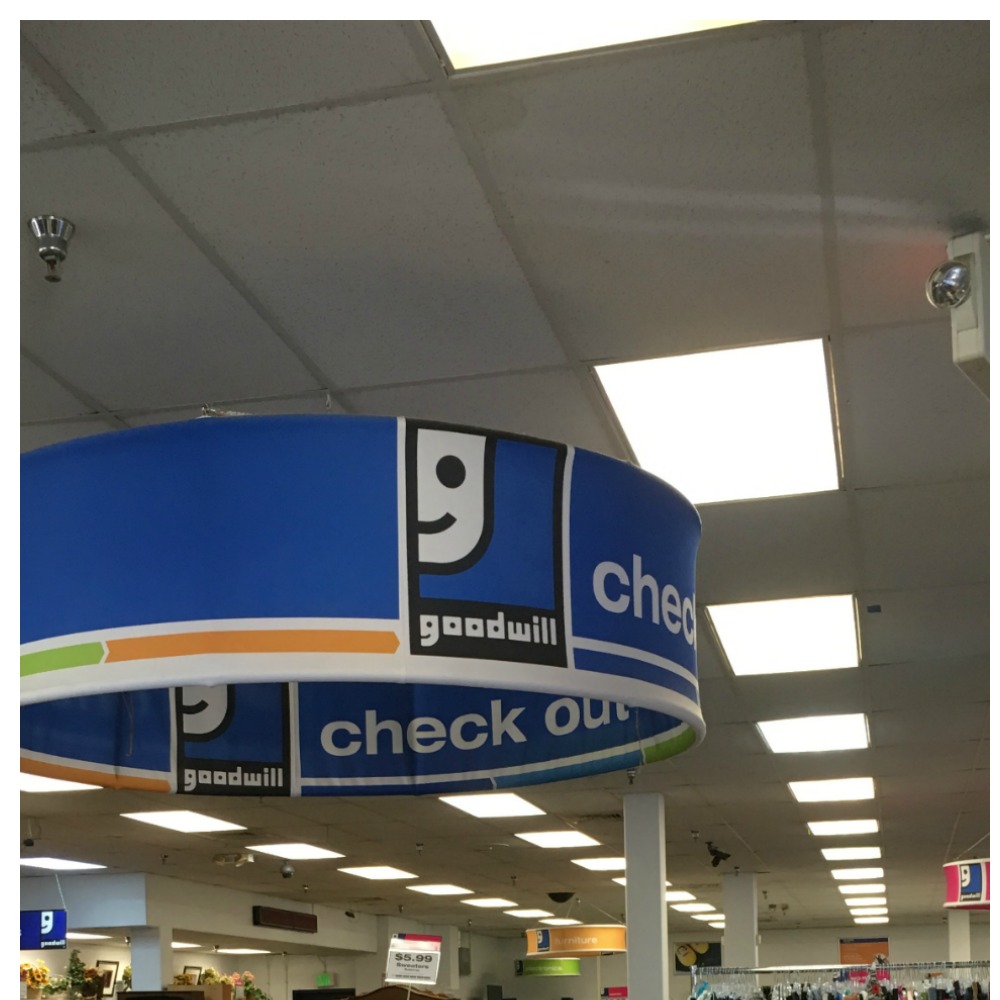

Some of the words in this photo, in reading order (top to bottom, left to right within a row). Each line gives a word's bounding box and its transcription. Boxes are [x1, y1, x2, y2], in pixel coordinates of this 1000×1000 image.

[592, 553, 697, 650] chec
[419, 612, 557, 647] goodwill
[320, 699, 527, 757] check
[184, 766, 283, 791] goodwill
[394, 952, 434, 963] $5.99
